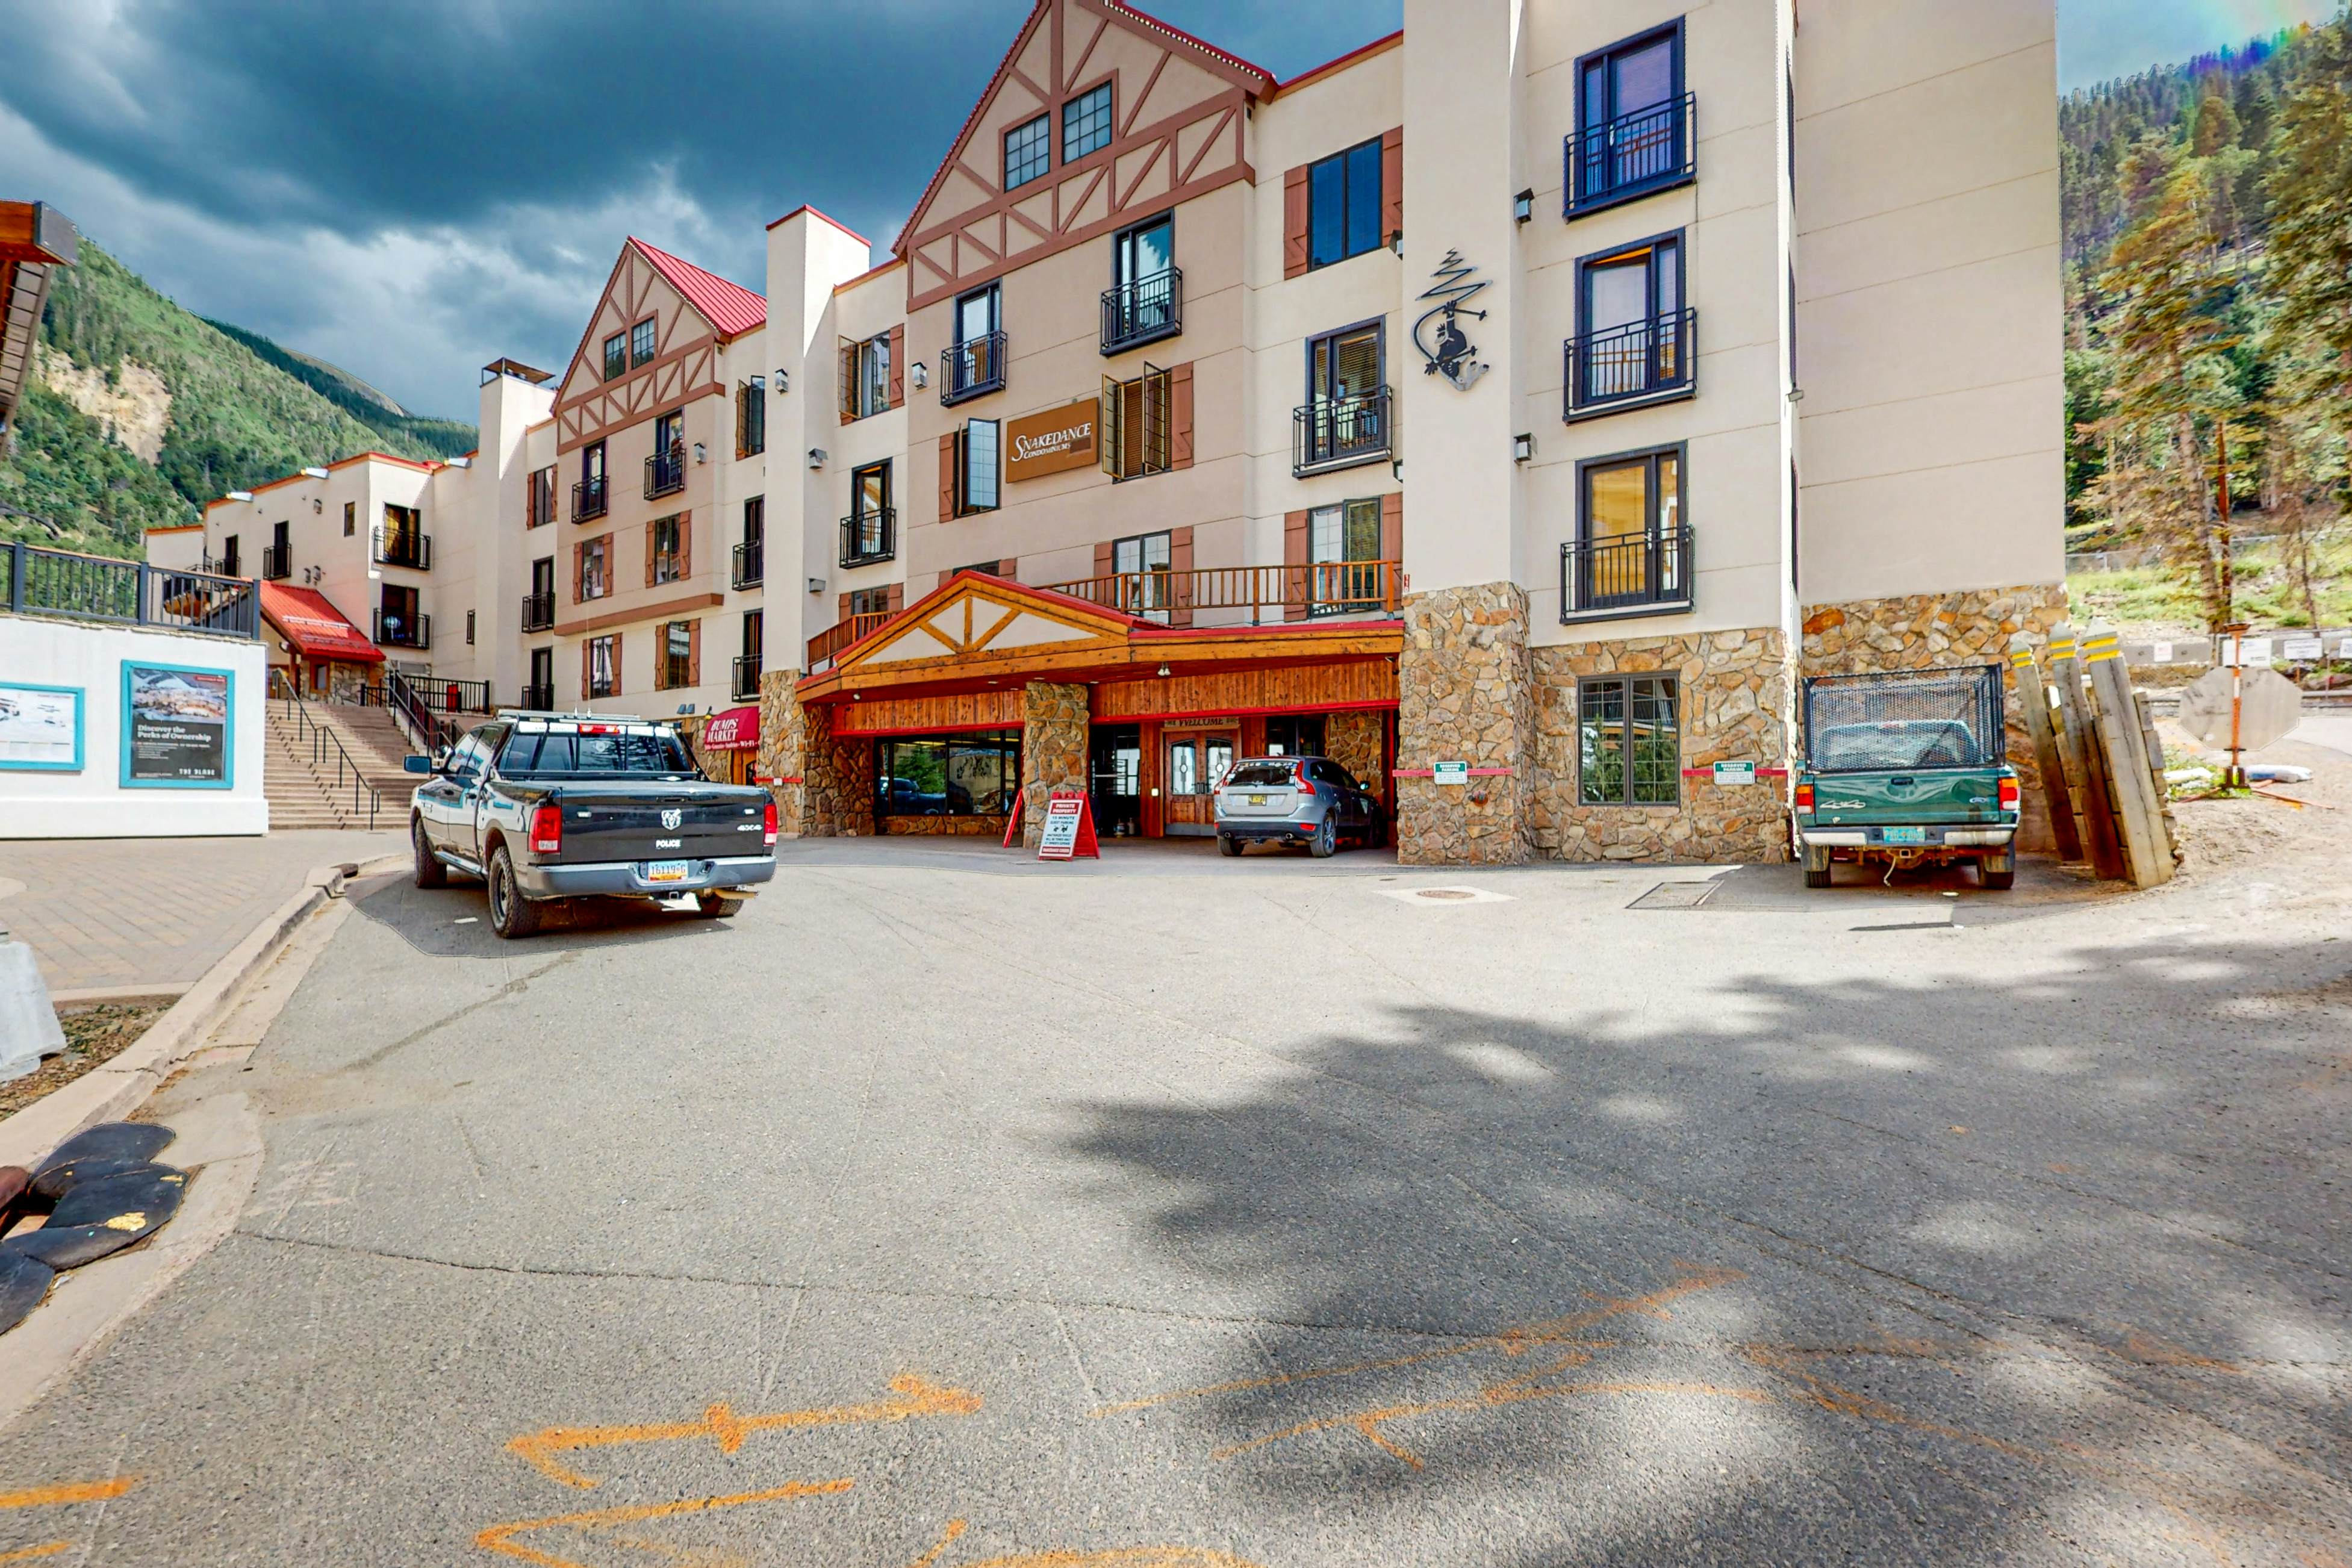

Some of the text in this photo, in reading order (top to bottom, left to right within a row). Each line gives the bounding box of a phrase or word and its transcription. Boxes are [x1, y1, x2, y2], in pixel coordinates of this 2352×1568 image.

[1011, 423, 1092, 462] SNAKEDANCE
[1024, 443, 1071, 459] CONDOMINIUMS
[170, 733, 211, 742] Ownership
[707, 729, 739, 743] MARKET
[656, 839, 682, 848] POLICE
